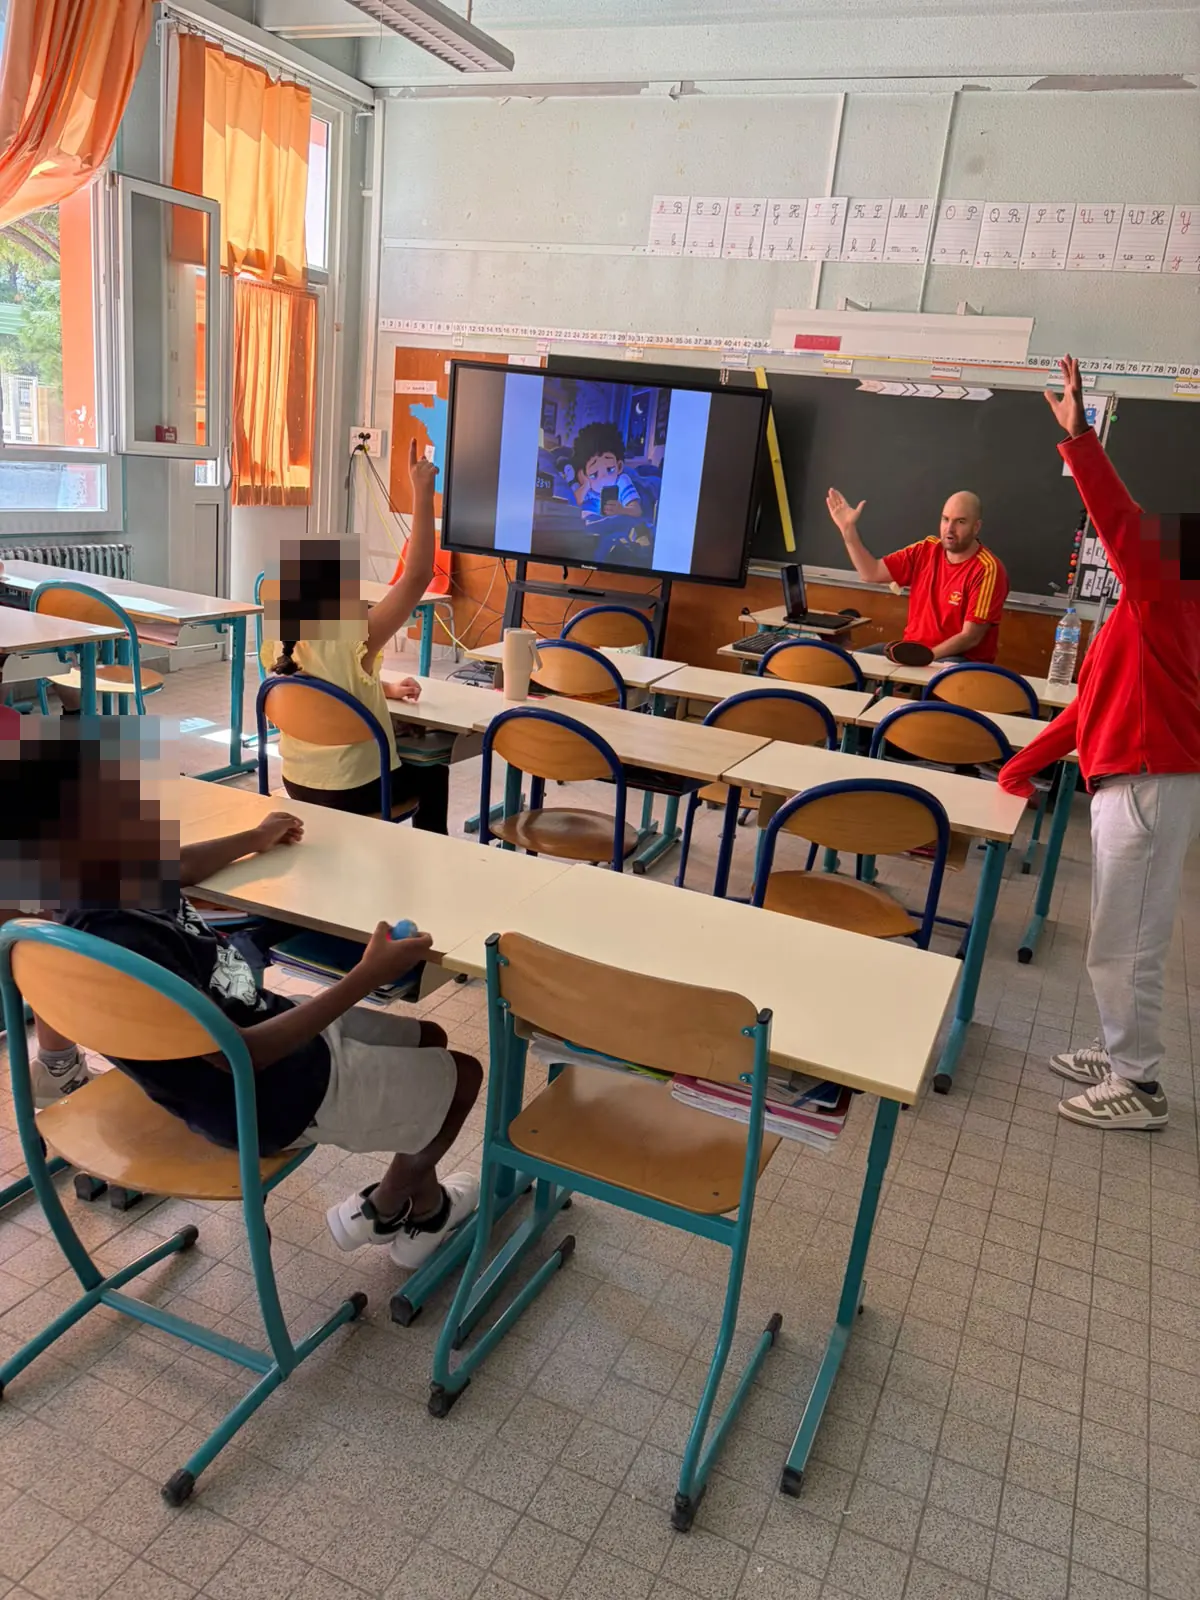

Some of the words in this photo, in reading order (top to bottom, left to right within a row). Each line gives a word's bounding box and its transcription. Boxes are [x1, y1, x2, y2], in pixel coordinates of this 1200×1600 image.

[1128, 364, 1138, 372] 76
[1154, 365, 1164, 373] 78
[1167, 366, 1177, 374] 79
[1180, 367, 1191, 375] 80
